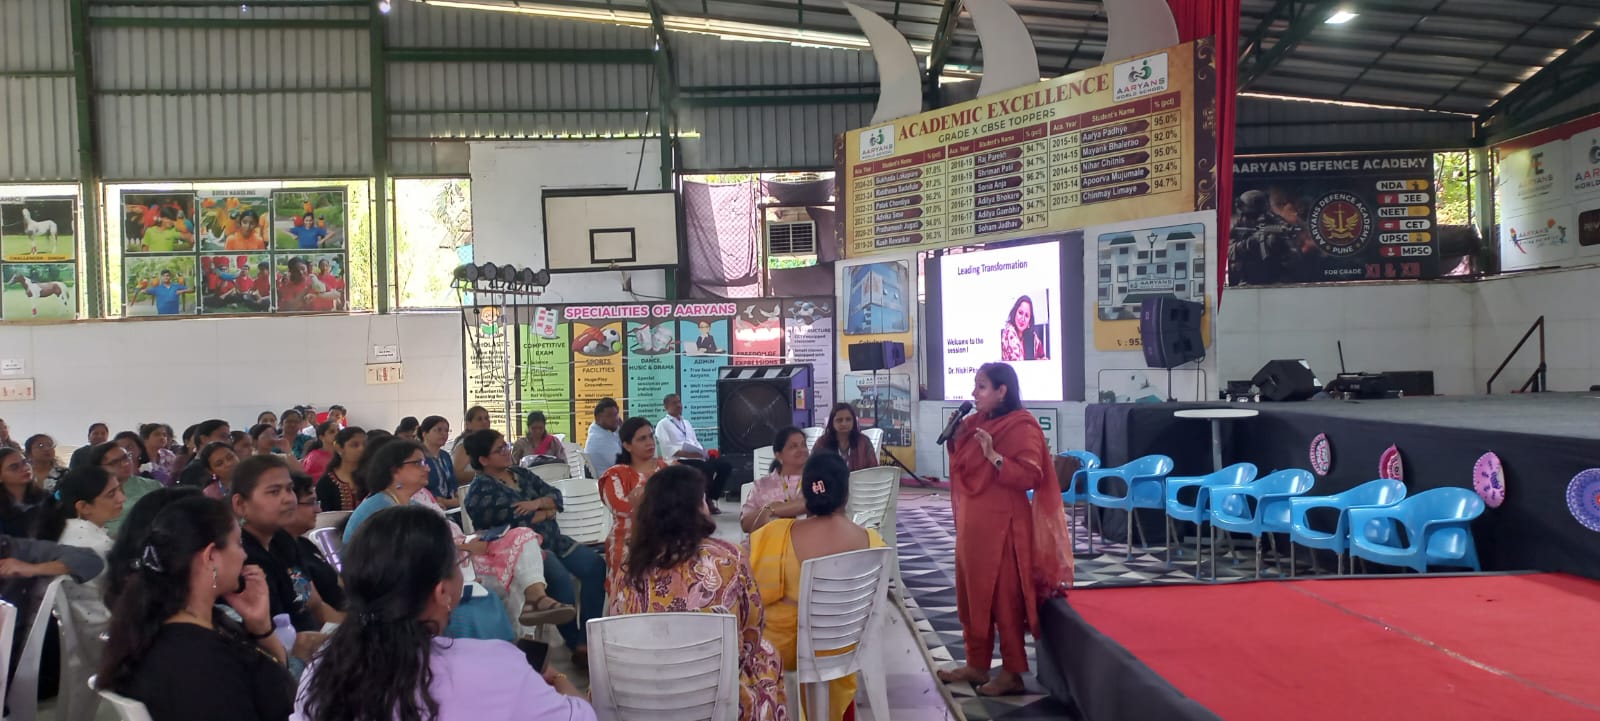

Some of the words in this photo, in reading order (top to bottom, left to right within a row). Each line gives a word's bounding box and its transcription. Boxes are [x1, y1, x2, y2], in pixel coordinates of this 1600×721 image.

[1116, 76, 1166, 94] AARYANS
[1116, 92, 1140, 100] WORLD
[1141, 86, 1165, 96] SCHOOL
[898, 106, 983, 142] ACADEMIC
[987, 73, 1110, 118] EXCELLENCE
[938, 128, 970, 143] GRADE
[968, 126, 978, 136] X
[981, 121, 1006, 134] CBSE
[1010, 108, 1056, 127] TOPPERS
[1053, 122, 1066, 132] Aca.
[1067, 120, 1077, 128] Year
[1092, 111, 1118, 122] Student's
[1118, 106, 1135, 116] Name
[1052, 135, 1078, 147] 2015-16
[1082, 130, 1102, 143] Aarya
[1102, 125, 1128, 137] Padhye
[1154, 115, 1178, 126] 95.0%
[978, 155, 987, 163] Raj
[988, 152, 1007, 160] Parekh
[1026, 143, 1045, 153] 94.7%
[1052, 150, 1078, 162] 2014-15
[1082, 144, 1108, 158] Mayank
[1108, 138, 1140, 151] Bhalerao
[1154, 130, 1178, 141] 92.0%
[978, 168, 1000, 177] Shriman
[1001, 164, 1014, 172] Patil
[1026, 158, 1045, 167] 94.7%
[1052, 165, 1078, 177] 2014-15
[1082, 159, 1100, 170] Nihar
[1101, 156, 1125, 167] Chitnis
[1154, 146, 1178, 157] 95.0%
[1232, 160, 1296, 173] AARYANS
[1300, 159, 1359, 171] DEFENCE
[1363, 158, 1428, 170] ACADEMY
[994, 180, 1007, 188] Anja
[1026, 172, 1045, 181] 96.2%
[1052, 180, 1078, 192] 2013-14
[1082, 174, 1110, 186] Apoorva
[1111, 168, 1144, 181] Mujumale
[1154, 162, 1178, 173] 92.4%
[978, 196, 995, 206] Aditya
[996, 192, 1020, 202] Bhokare
[1026, 186, 1045, 195] 94.7%
[1052, 194, 1078, 205] 2012-13
[1082, 189, 1111, 201] Chinmay
[1112, 184, 1137, 196] Limaye
[1154, 177, 1178, 188] 94.7%
[1404, 194, 1422, 202] JEE
[978, 209, 995, 218] Aditya
[996, 206, 1020, 215] Gambhir
[1026, 200, 1045, 209] 94.7%
[1381, 208, 1406, 216] NEET
[951, 226, 972, 236] 2016-17
[978, 223, 997, 232] Soham
[998, 220, 1018, 229] Jadhav
[1026, 214, 1045, 224] 94.7%
[1314, 206, 1326, 245] AARYANS
[1320, 194, 1356, 208] DEFENCE
[1355, 200, 1370, 242] ACADEMY
[1382, 234, 1408, 242] UPSC
[1332, 246, 1354, 255] PUNE
[1402, 247, 1430, 255] MPSC
[958, 266, 980, 276] Leading
[982, 259, 1028, 273] Transformation
[1365, 264, 1380, 277] XI
[1384, 264, 1396, 276] &
[1401, 262, 1420, 276] XII
[566, 306, 648, 318] SPECIALITIES
[652, 304, 672, 316] OF
[674, 303, 736, 316] AARYANS
